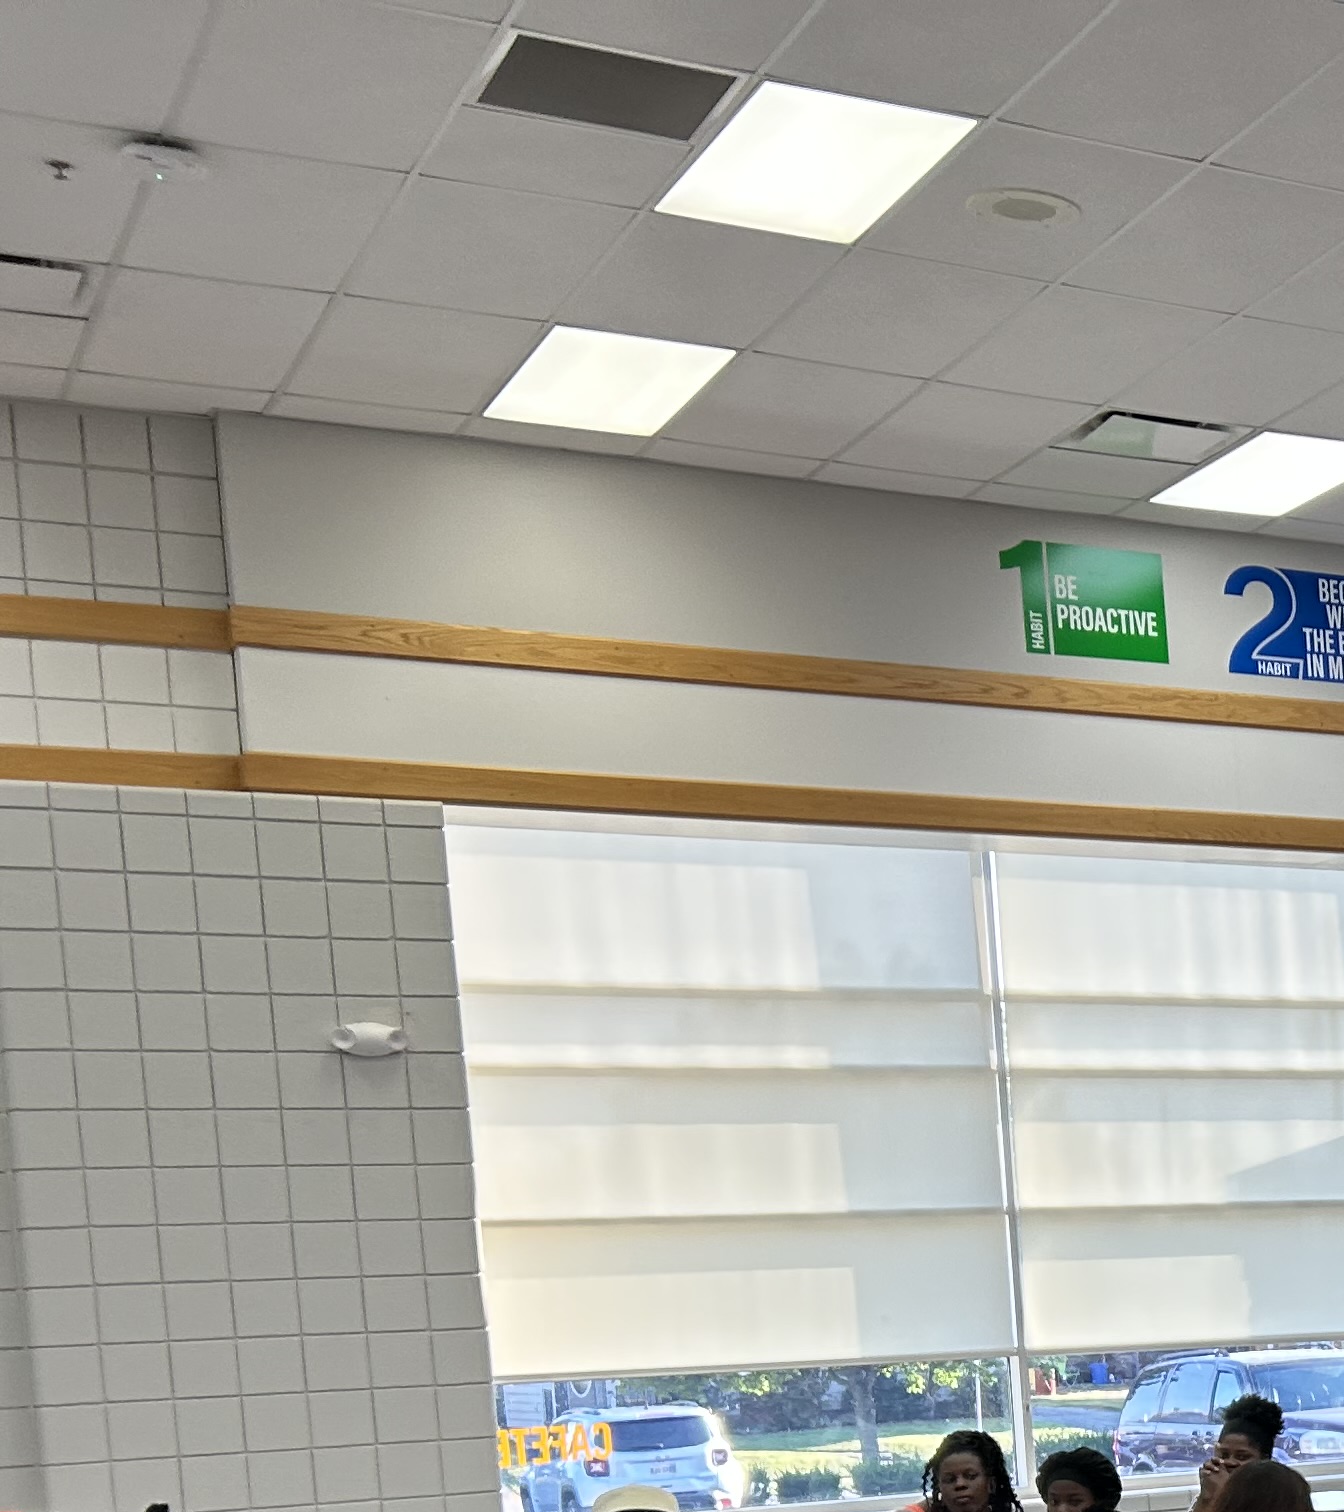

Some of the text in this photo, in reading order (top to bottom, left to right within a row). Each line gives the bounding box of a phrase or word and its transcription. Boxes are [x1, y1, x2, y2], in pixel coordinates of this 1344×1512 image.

[1054, 574, 1079, 601] BE
[1030, 610, 1045, 649] HABIT
[1056, 604, 1159, 637] PROACTIVE
[1224, 565, 1301, 679] 2
[1302, 627, 1336, 654] THE
[1257, 660, 1292, 676] HABIT
[1306, 653, 1325, 679] IN
